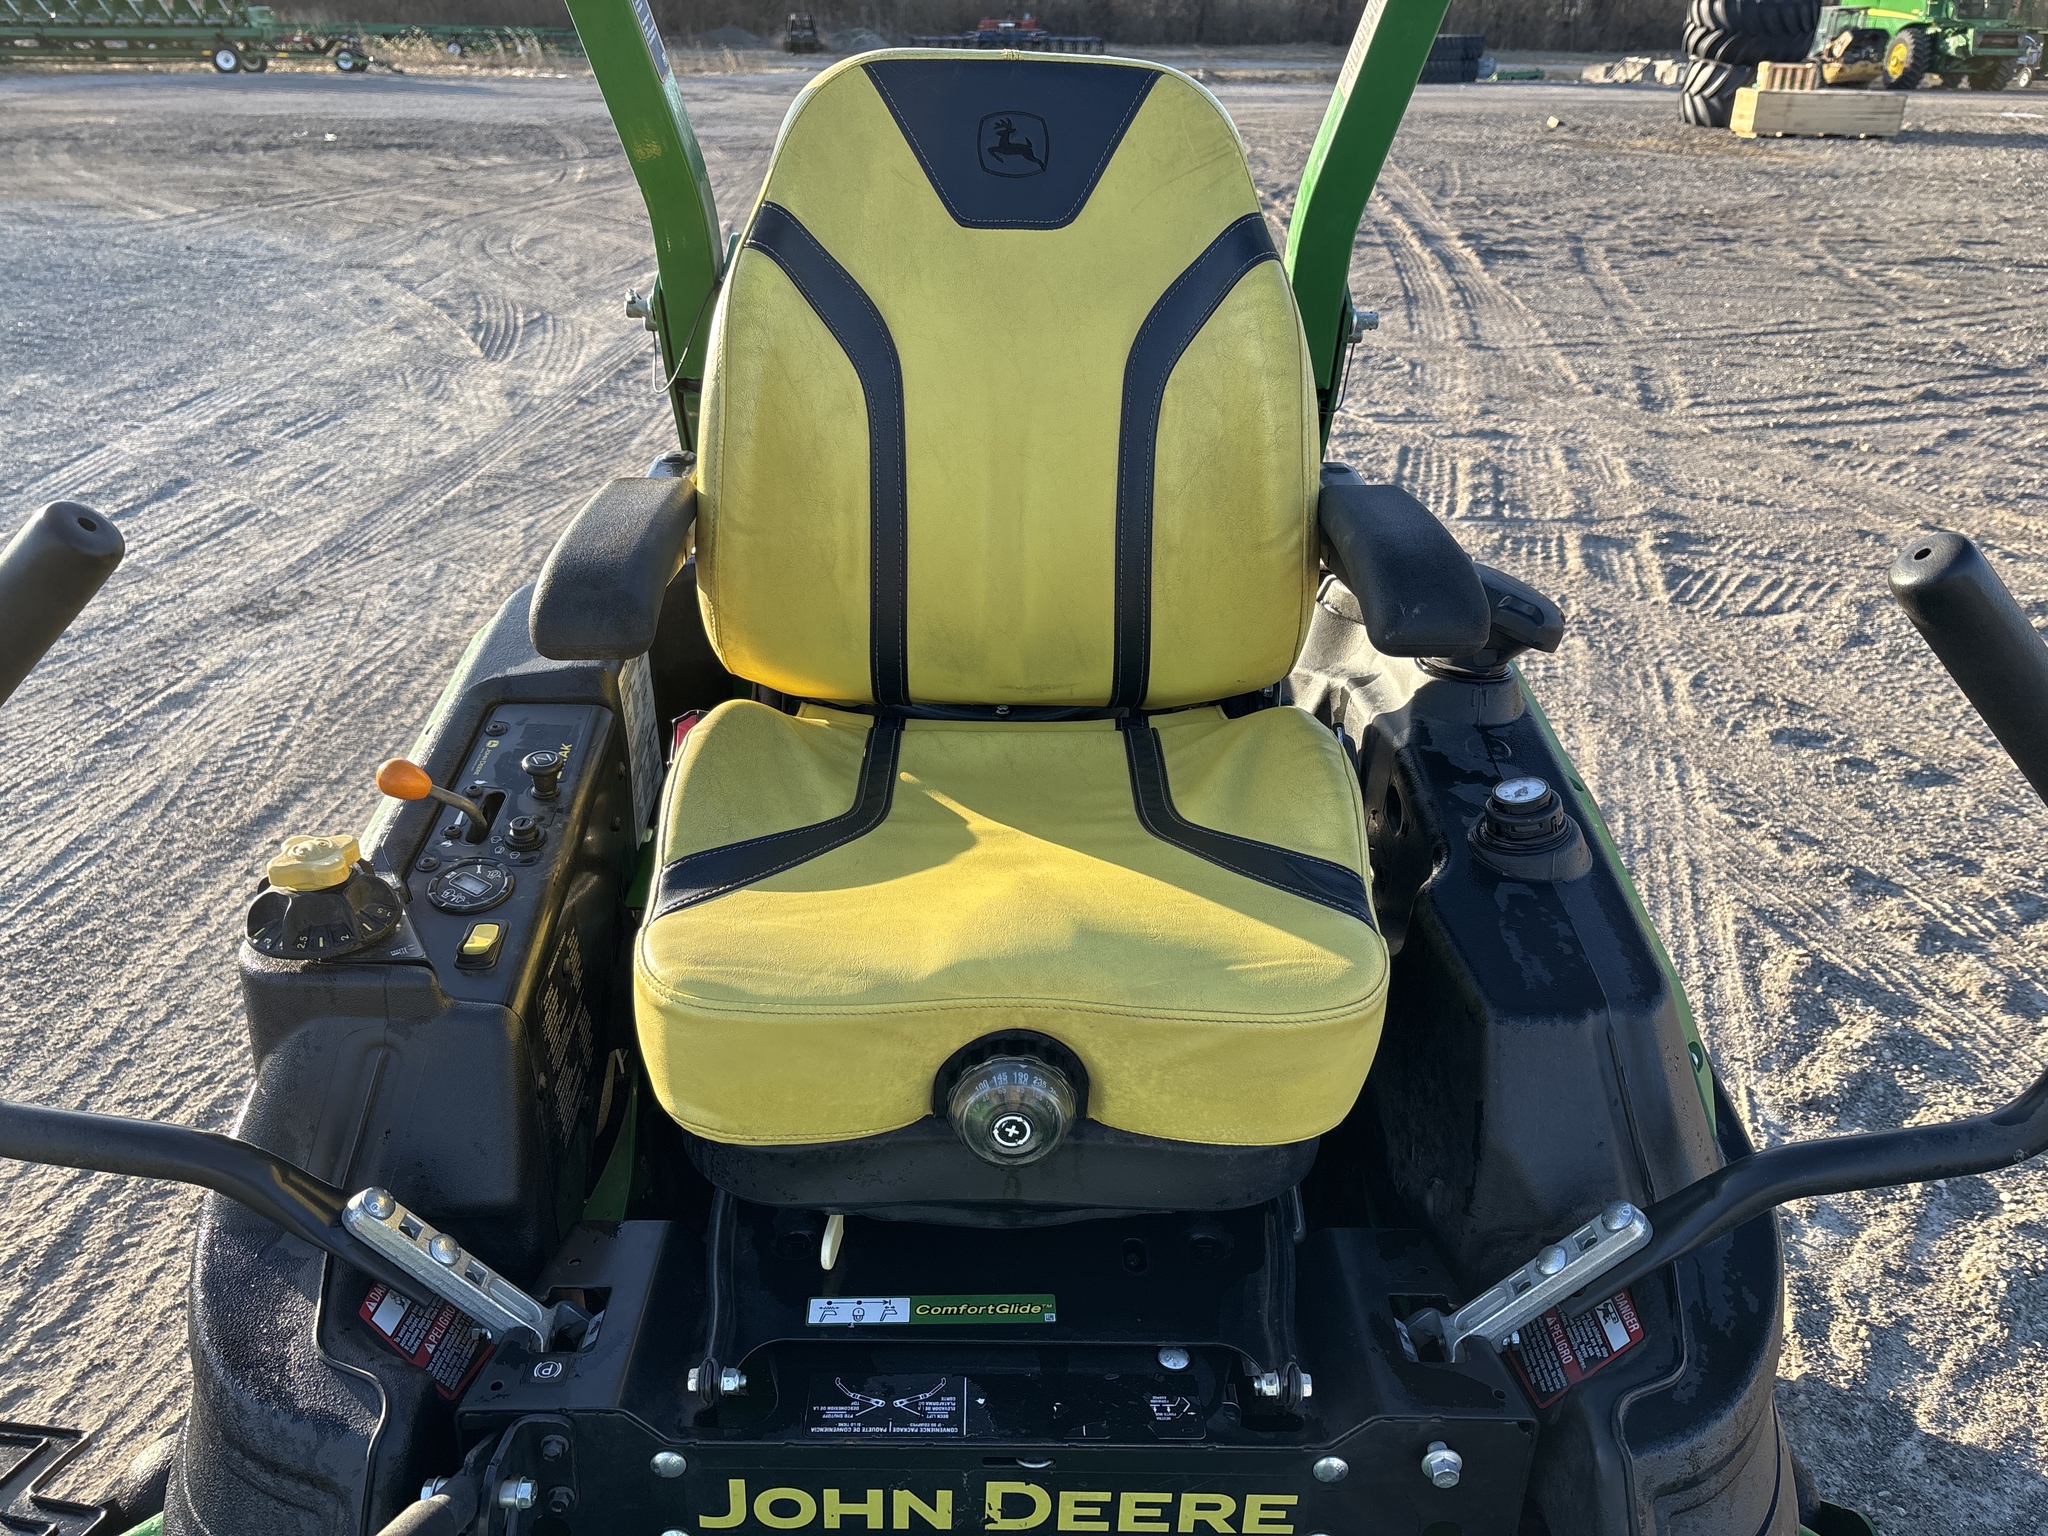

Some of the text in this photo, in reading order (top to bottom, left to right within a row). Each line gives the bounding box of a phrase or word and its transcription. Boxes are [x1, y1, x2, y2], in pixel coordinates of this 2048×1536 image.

[297, 936, 308, 949] 2.5
[341, 934, 350, 942] 2
[992, 1072, 1008, 1086] 145
[1013, 1072, 1029, 1085] 190
[430, 1304, 456, 1344] PELIGRO
[1614, 1293, 1639, 1333] DANGER
[1553, 1325, 1573, 1364] PELIGRO
[699, 1479, 1299, 1535] JOHN DEERE
